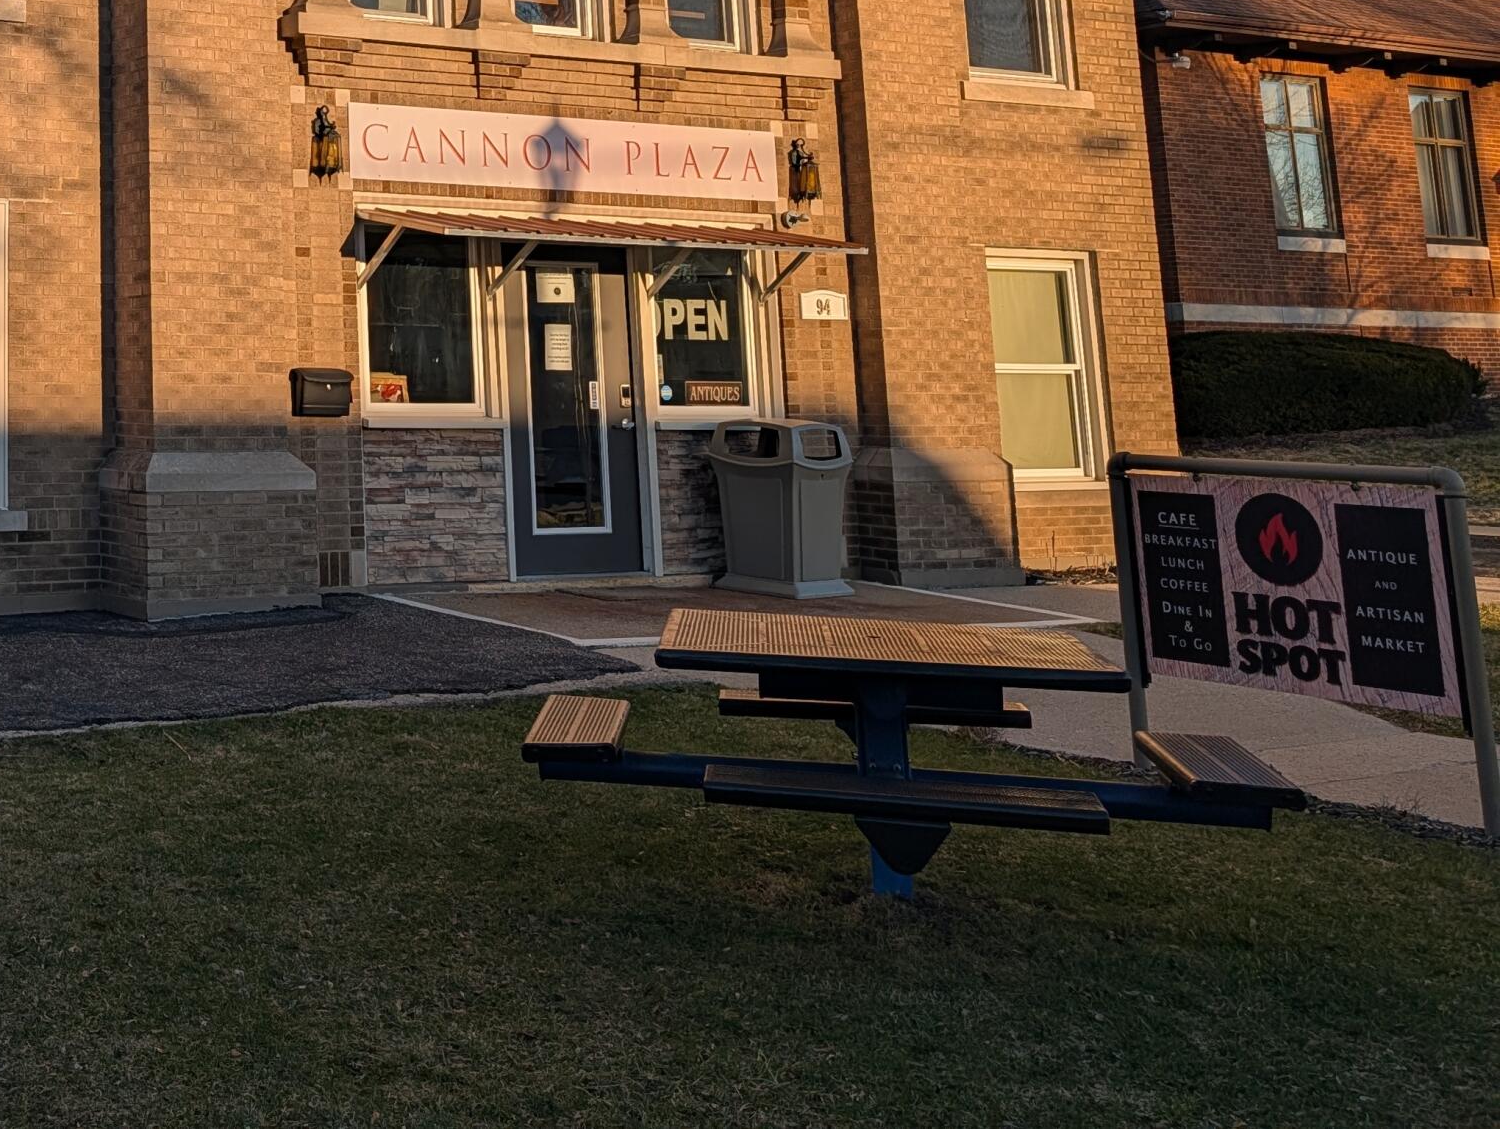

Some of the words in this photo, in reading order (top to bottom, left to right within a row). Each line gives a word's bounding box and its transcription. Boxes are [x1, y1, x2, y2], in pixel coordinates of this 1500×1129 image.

[362, 123, 592, 173] CANNON
[625, 140, 765, 183] PLAZA
[816, 298, 831, 316] 94
[690, 386, 740, 402] ANTIQUES
[1157, 511, 1197, 526] CAFE
[1144, 533, 1217, 550] BREAKFAST
[1161, 556, 1204, 570] LUNCH
[1346, 549, 1418, 565] ANTIQUE
[1160, 578, 1209, 593] COFFEE
[1374, 580, 1397, 591] AND
[1231, 591, 1342, 645] HOT
[1355, 606, 1425, 624] ARTISAN
[1184, 620, 1193, 632] &
[1361, 635, 1425, 654] MARKET
[1237, 638, 1346, 686] SPOT
